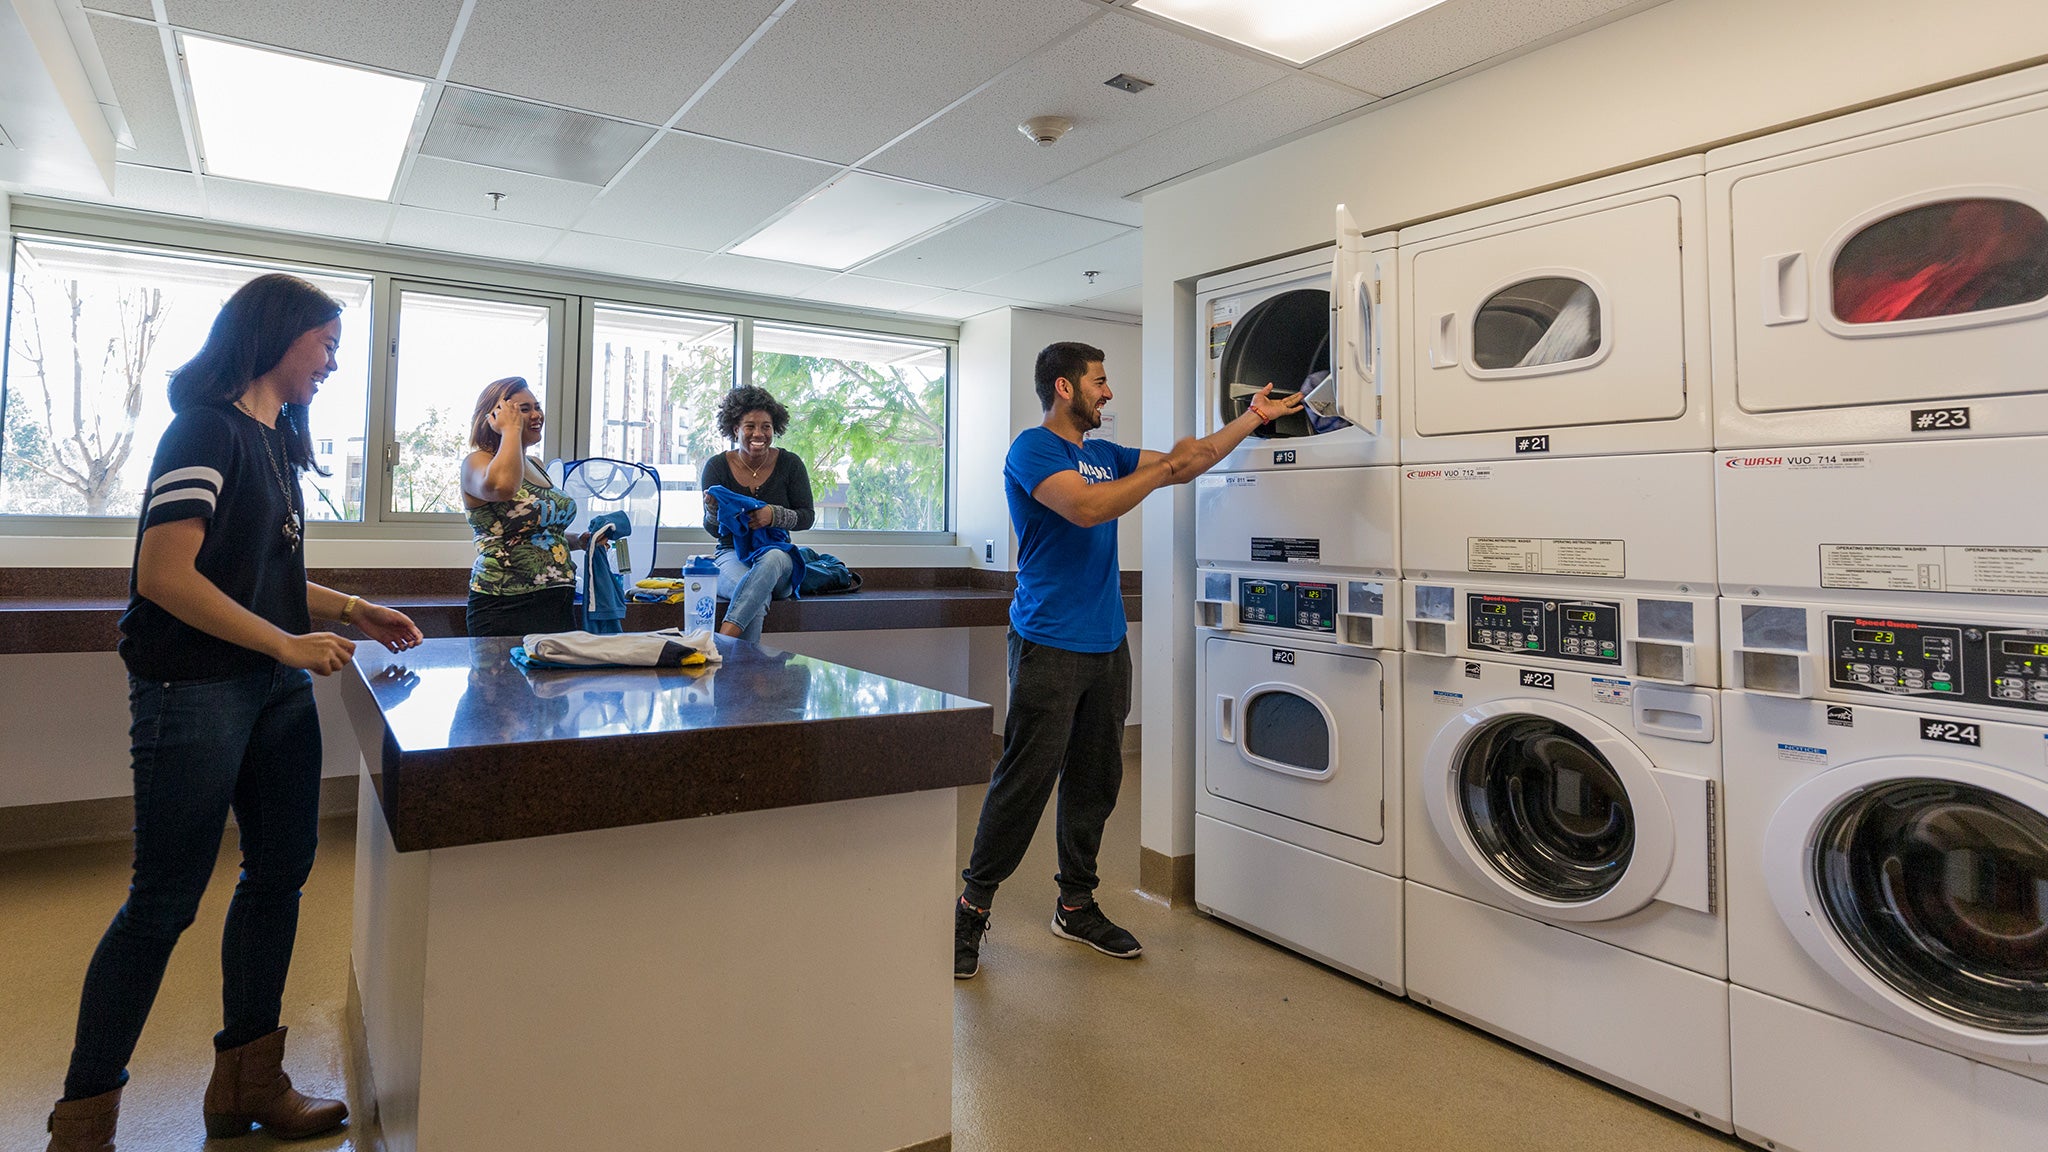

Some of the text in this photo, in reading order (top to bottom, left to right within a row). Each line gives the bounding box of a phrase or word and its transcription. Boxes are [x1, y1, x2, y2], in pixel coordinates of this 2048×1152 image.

[1916, 410, 1967, 427] #23
[1518, 437, 1546, 450] #21
[1275, 451, 1294, 463] #19
[1743, 455, 1837, 466] WASH VUO 714
[1495, 605, 1506, 615] 23
[1582, 612, 1596, 621] 20
[1855, 618, 1918, 629] Speed Queen
[1874, 631, 1893, 643] 23
[2033, 644, 2048, 656] 19
[1274, 651, 1294, 663] #20
[1523, 673, 1553, 687] #22
[1926, 722, 1978, 743] #24
